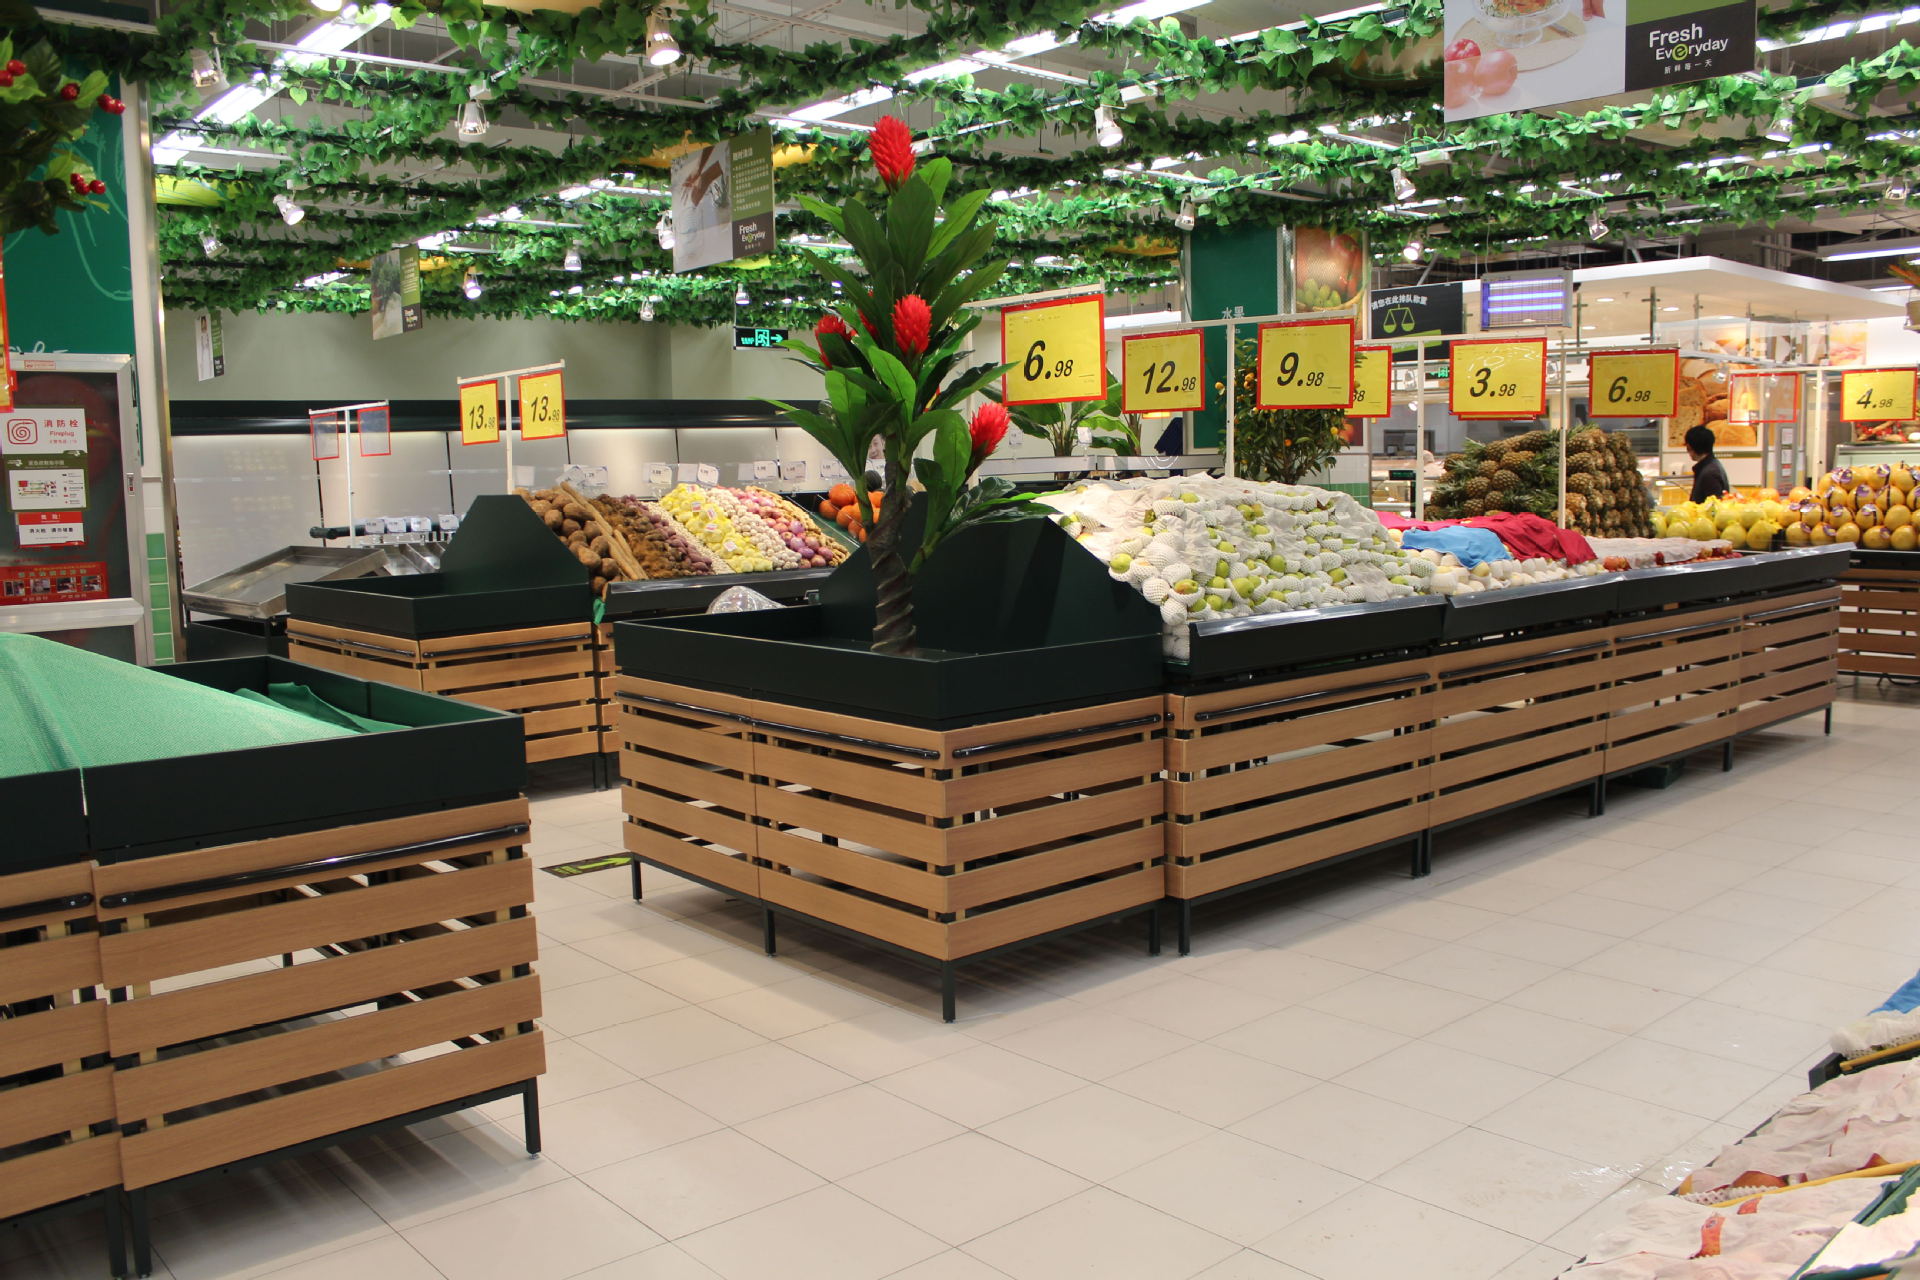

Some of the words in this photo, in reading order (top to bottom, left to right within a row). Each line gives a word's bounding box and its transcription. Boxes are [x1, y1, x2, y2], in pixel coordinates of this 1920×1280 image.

[1649, 22, 1703, 49] Fresh
[1655, 38, 1729, 61] Everyday
[739, 222, 757, 235] Fresh
[1023, 339, 1074, 382] 6.98
[1276, 351, 1325, 387] 9.98
[1142, 360, 1197, 395] 12.98
[1469, 367, 1517, 398] 3.98
[1607, 375, 1652, 404] 6.98
[530, 395, 560, 423] 13.98
[1856, 388, 1893, 410] 4.98
[44, 419, 79, 428] 消防栓
